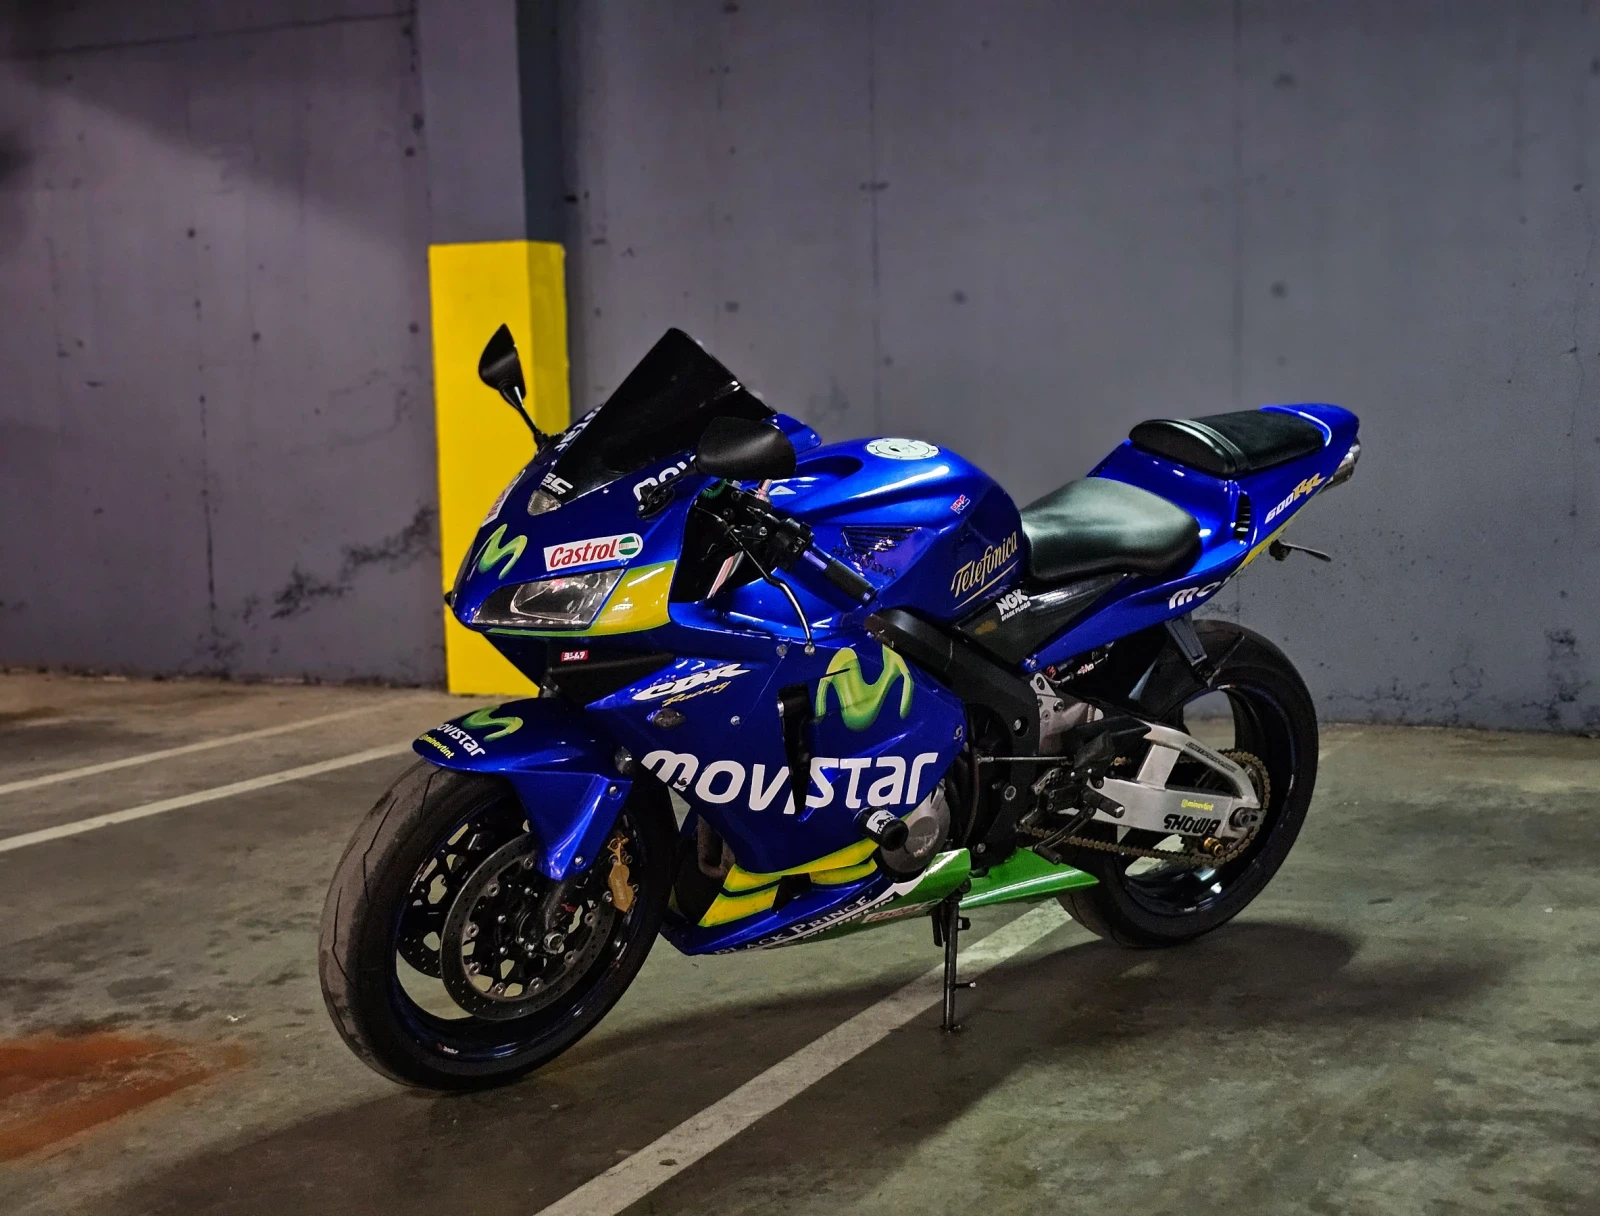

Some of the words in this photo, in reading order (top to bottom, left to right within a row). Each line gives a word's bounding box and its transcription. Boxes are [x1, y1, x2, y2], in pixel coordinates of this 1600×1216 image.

[550, 539, 618, 568] Castrol
[996, 589, 1028, 615] NGK
[632, 664, 751, 700] CBR
[1164, 814, 1222, 834] SHOWA
[789, 896, 873, 935] PRINCE
